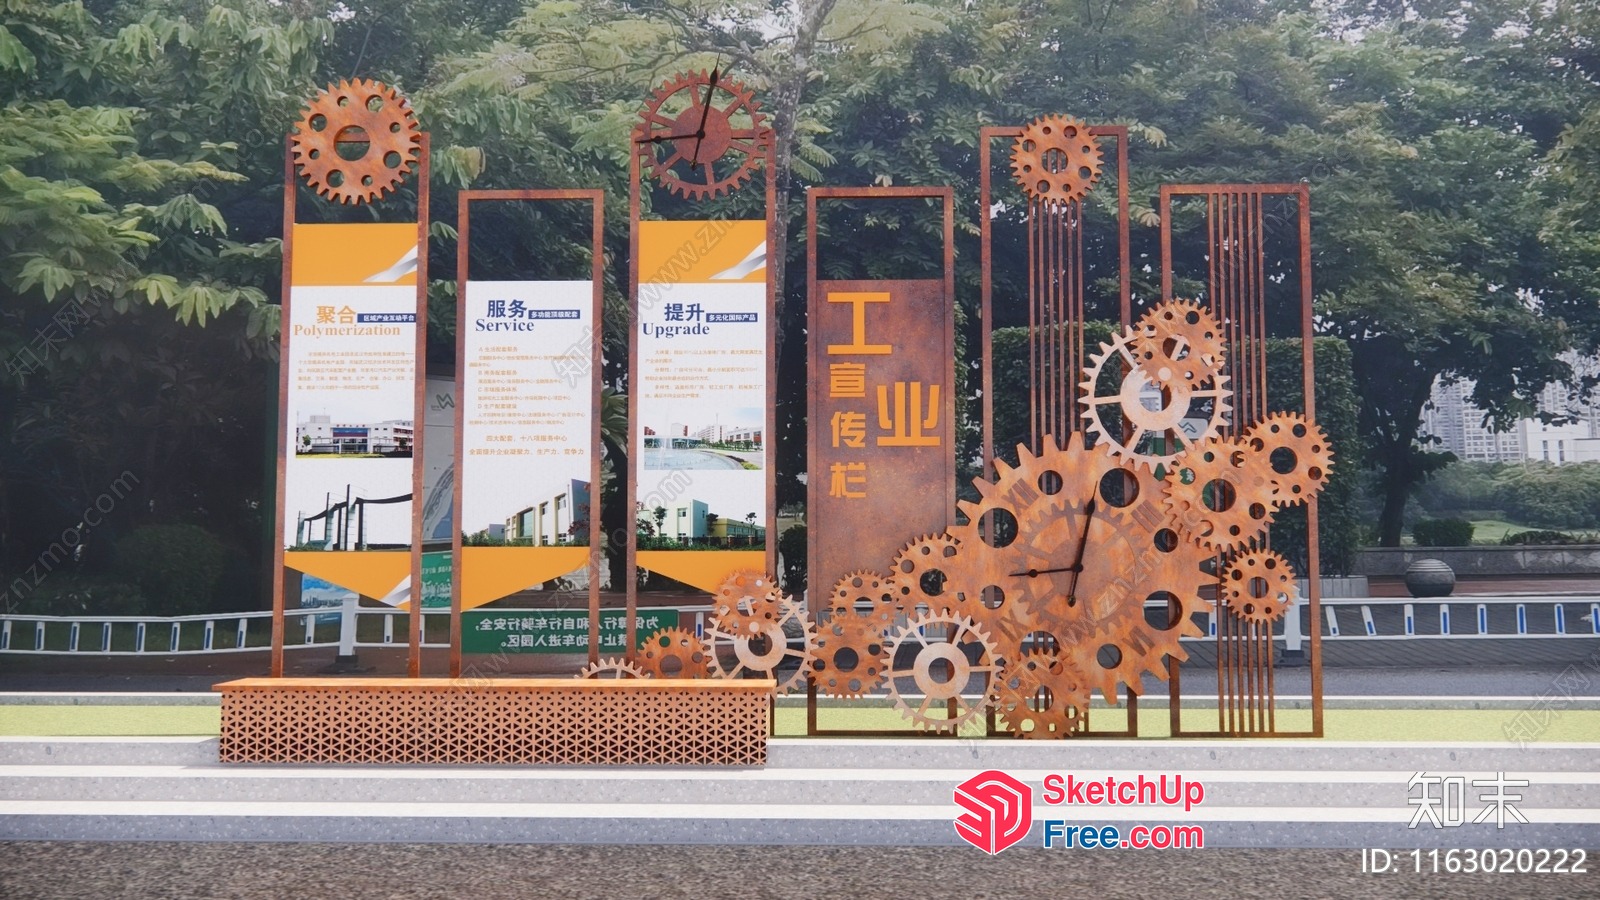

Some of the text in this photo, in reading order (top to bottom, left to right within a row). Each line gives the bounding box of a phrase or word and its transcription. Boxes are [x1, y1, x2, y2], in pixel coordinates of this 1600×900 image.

[316, 305, 356, 324] 聚合
[487, 299, 527, 318] 服务
[531, 310, 578, 318] 多功能顶级配套
[664, 303, 704, 321] 提升
[363, 314, 415, 322] 区域产业互动平台
[476, 318, 534, 332] Service
[709, 314, 756, 322] 多元化国际产品
[294, 324, 400, 339] Polymerization
[643, 322, 710, 338] Upgrade
[827, 292, 940, 446] 工 业
[829, 362, 866, 498] 宣传栏
